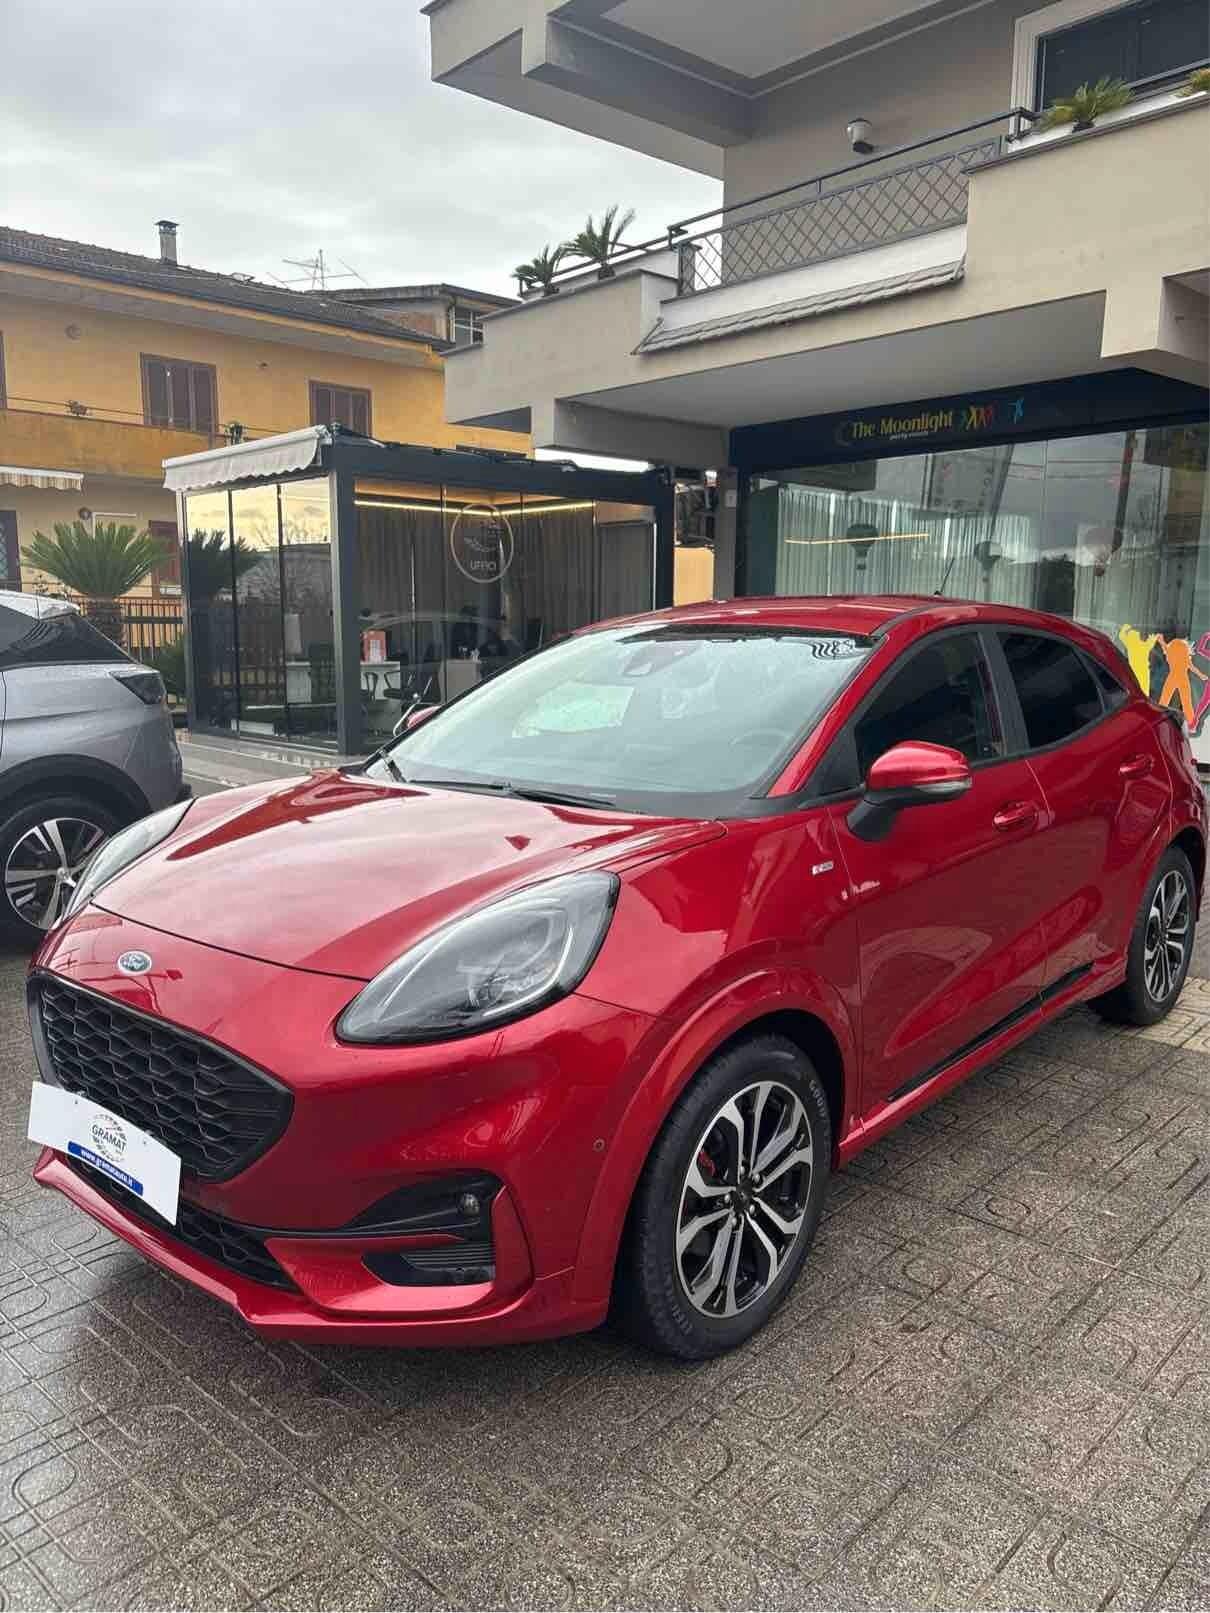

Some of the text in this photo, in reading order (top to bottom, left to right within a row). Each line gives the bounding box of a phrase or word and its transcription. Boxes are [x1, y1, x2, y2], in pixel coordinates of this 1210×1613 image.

[852, 410, 953, 439] The Moonlight
[92, 1124, 126, 1151] GRAMAT
